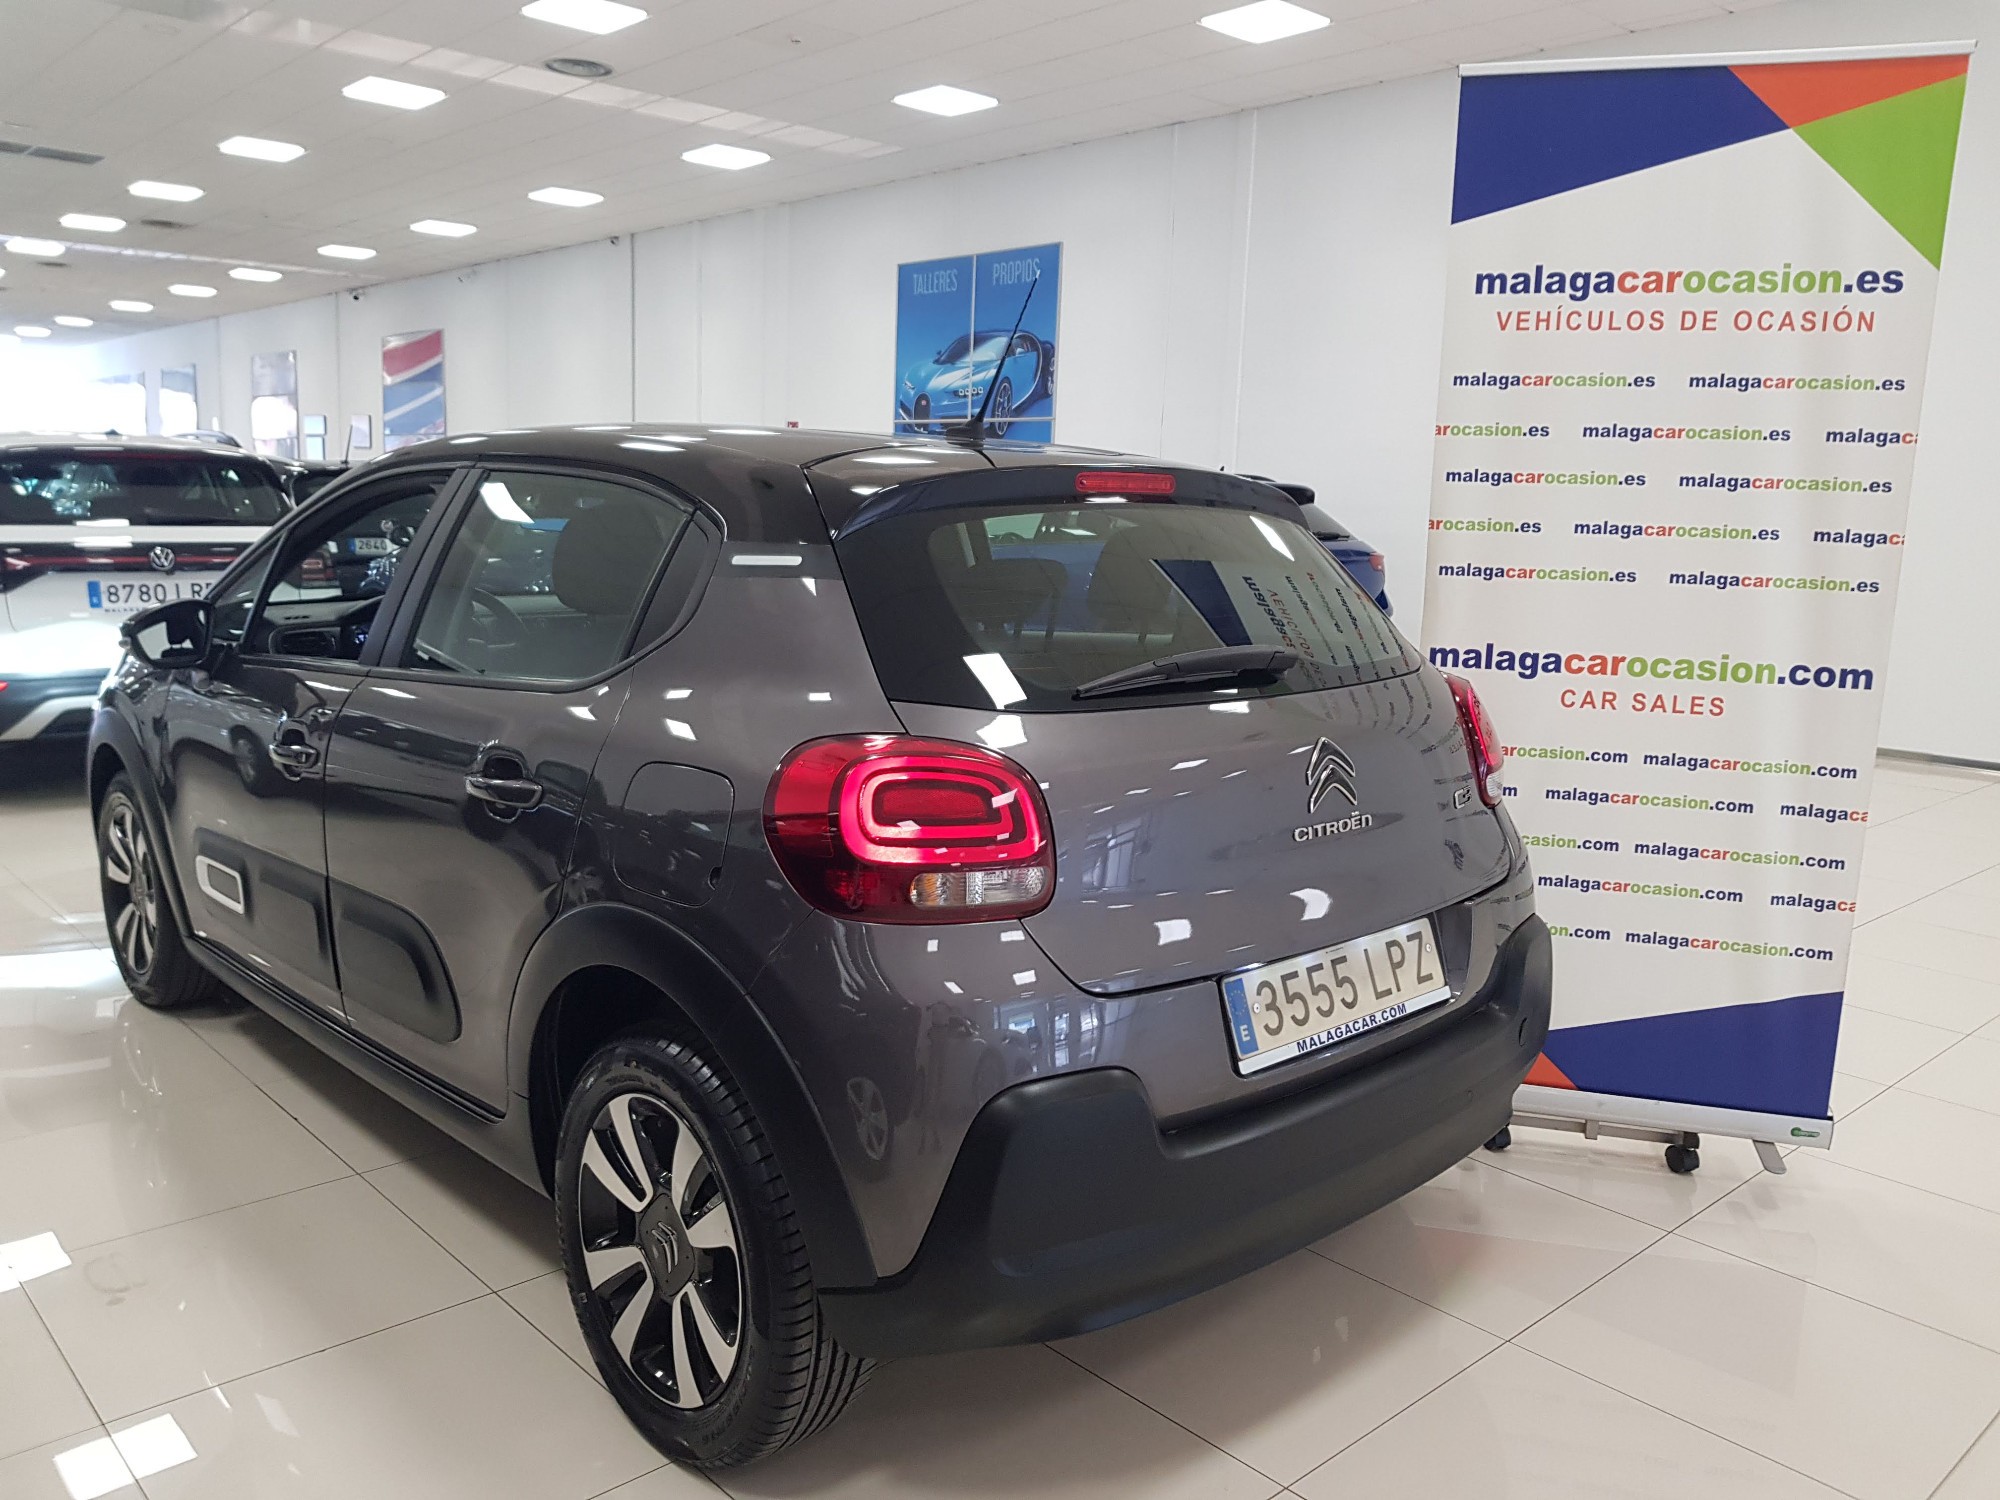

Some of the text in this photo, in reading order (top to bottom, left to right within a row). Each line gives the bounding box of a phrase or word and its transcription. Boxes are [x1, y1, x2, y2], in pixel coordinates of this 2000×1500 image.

[913, 268, 958, 294] TALLERES
[992, 257, 1040, 286] PROPIOS
[1474, 262, 1904, 301] malagacarocasion.es
[1496, 304, 1875, 332] VEHÍCULOS DE OCASIÓN
[1452, 371, 1906, 392] malagacarocasion.es malagacarocasion.es
[1582, 422, 1791, 442] malagacarocasion.es
[1445, 468, 1893, 493] malagacarocasion.es malagacarocasion.es
[1573, 520, 1780, 540] malagacarocasion.es
[1438, 562, 1880, 593] malagacarocasion.es malagacarocasion.es
[107, 584, 166, 603] 8780
[1429, 643, 1874, 691] malagacarocasion.com
[1560, 688, 1725, 716] CAR SALES
[1642, 752, 1858, 779] malagacarocasion.com
[1545, 787, 1754, 813] malagacarocasion.com
[1633, 841, 1846, 870] malagacarocasion.com
[1537, 874, 1744, 902] malagacarocasion.com
[1625, 931, 1834, 960] malagacarocasion.com
[1256, 930, 1434, 1036] 3555 LPZ
[1240, 1025, 1251, 1041] E
[1296, 1003, 1408, 1053] MALAGACAR.COM
